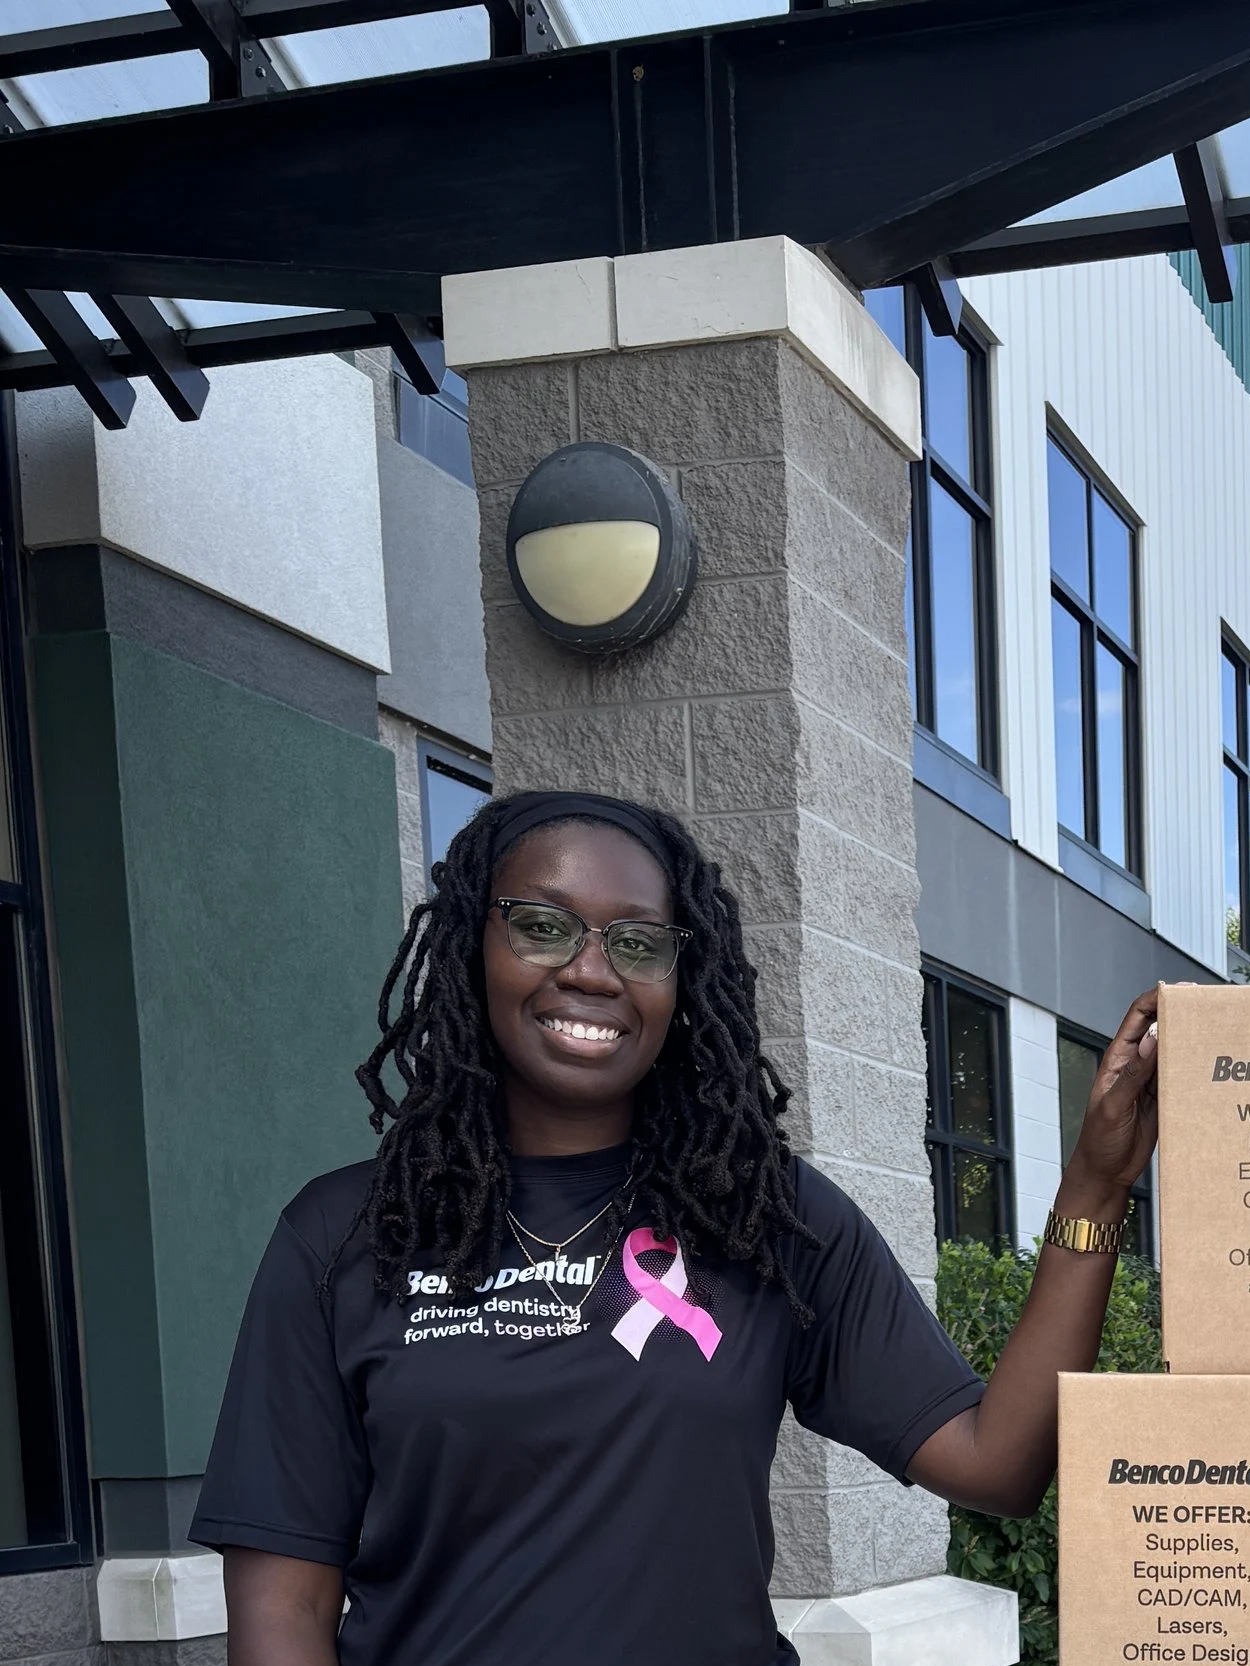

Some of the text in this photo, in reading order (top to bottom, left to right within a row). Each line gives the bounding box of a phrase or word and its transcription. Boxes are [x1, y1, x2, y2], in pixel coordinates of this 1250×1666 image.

[410, 1304, 479, 1324] driving
[404, 1320, 489, 1345] forward,
[1132, 1506, 1168, 1523] WE
[1146, 1533, 1238, 1556] Supplies,
[1134, 1561, 1250, 1584] Equipment,
[1138, 1589, 1247, 1610] CAD/CAM,
[1158, 1617, 1227, 1637] Lasers,
[1123, 1643, 1185, 1661] Office
